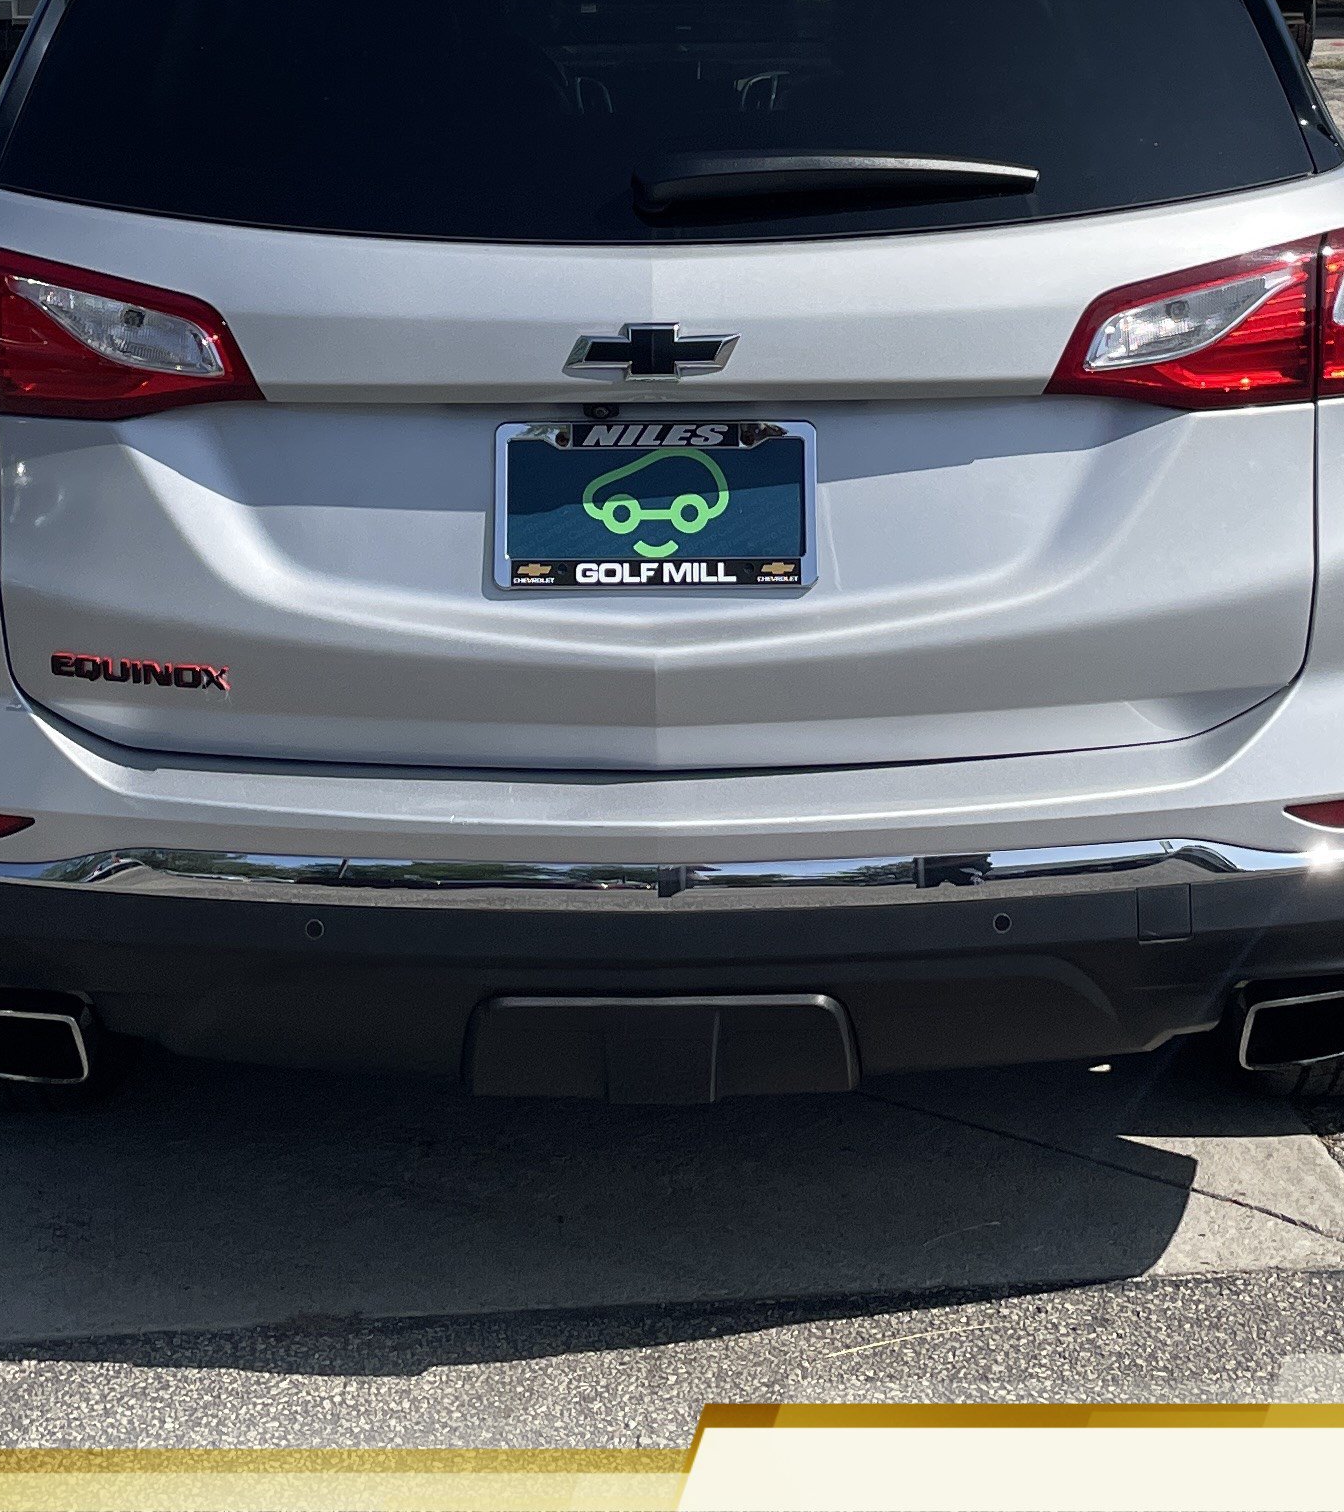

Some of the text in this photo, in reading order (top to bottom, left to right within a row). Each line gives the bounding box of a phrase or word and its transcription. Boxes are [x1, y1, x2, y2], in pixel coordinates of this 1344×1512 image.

[582, 424, 730, 447] NILES
[575, 561, 737, 583] GOLF MILL
[50, 652, 232, 692] EQUINOX
